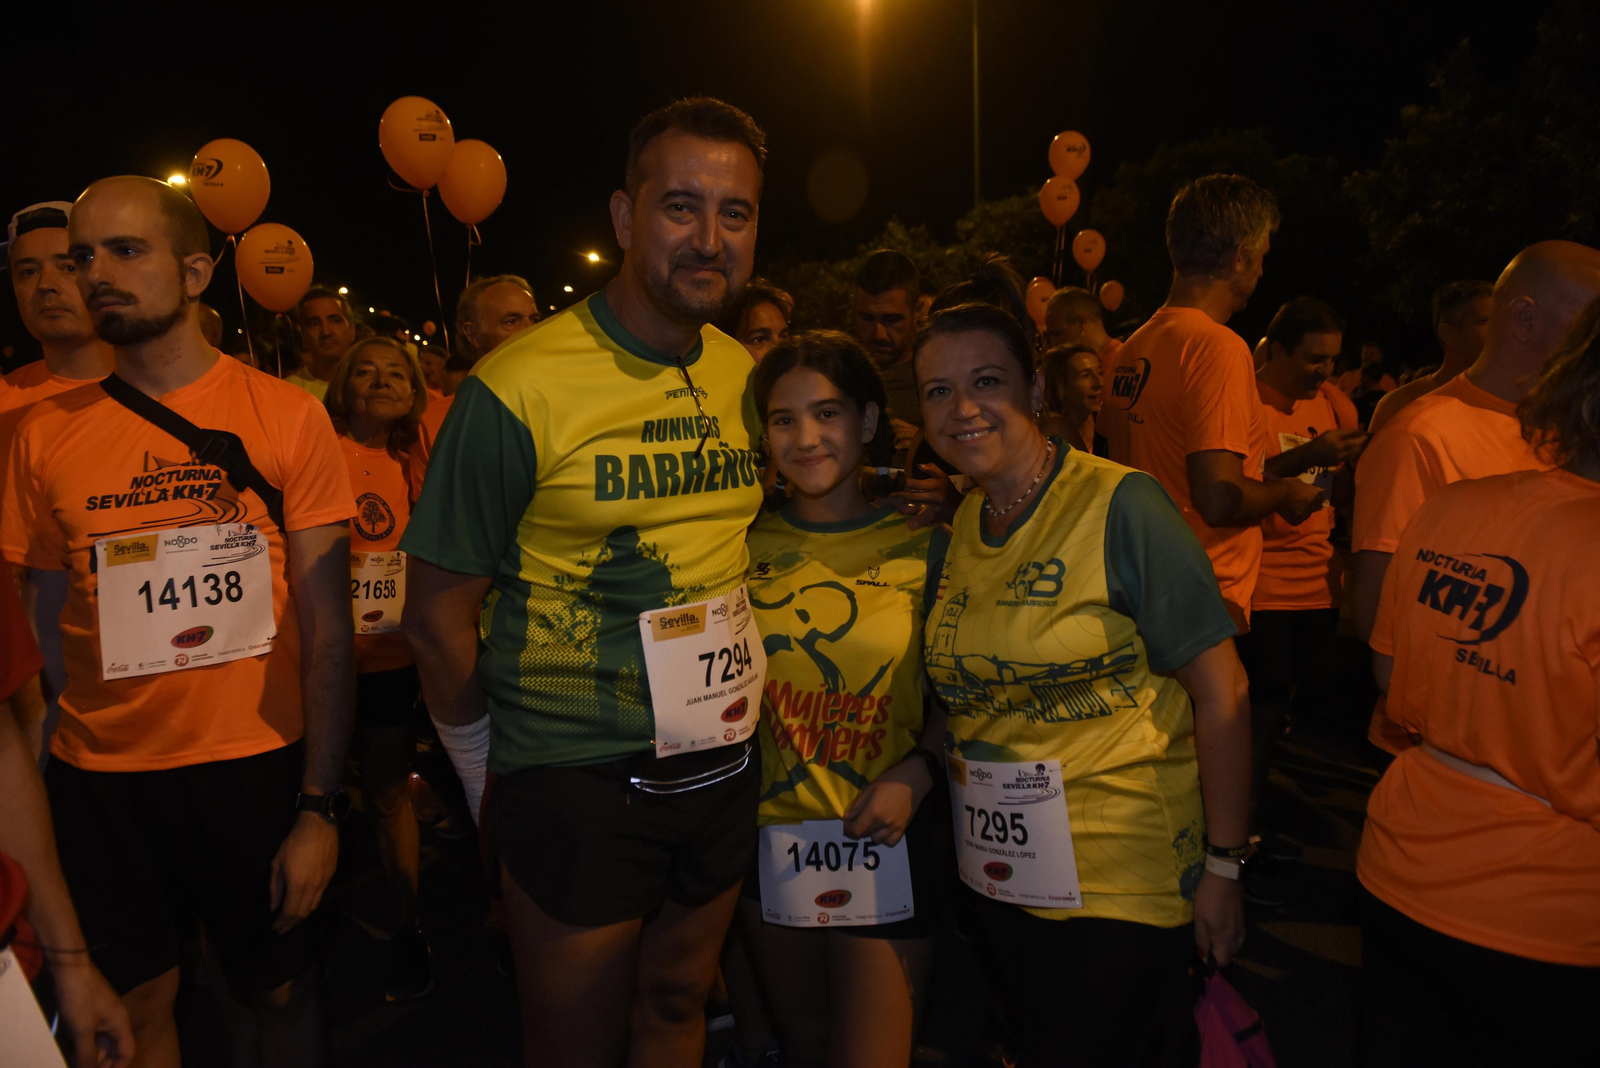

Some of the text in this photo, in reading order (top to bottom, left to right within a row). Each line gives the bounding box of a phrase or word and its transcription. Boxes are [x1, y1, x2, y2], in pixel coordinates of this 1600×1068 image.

[641, 415, 720, 443] RUNNERS
[130, 469, 222, 489] NOCTURNA
[85, 489, 168, 511] SEVILLA
[210, 541, 239, 551] SEVILLA
[224, 535, 257, 543] NOCTURNA
[138, 571, 244, 613] 14138
[351, 579, 396, 599] 21658
[855, 579, 890, 587] SPALL
[699, 638, 752, 687] 7294
[686, 697, 702, 706] JUAN
[703, 690, 727, 702] MANUEL
[765, 679, 893, 734] Mujeres
[763, 703, 887, 767] unners
[965, 804, 1028, 846] 7295
[787, 842, 880, 872] 14075
[1016, 851, 1036, 859] LÓPEZ
